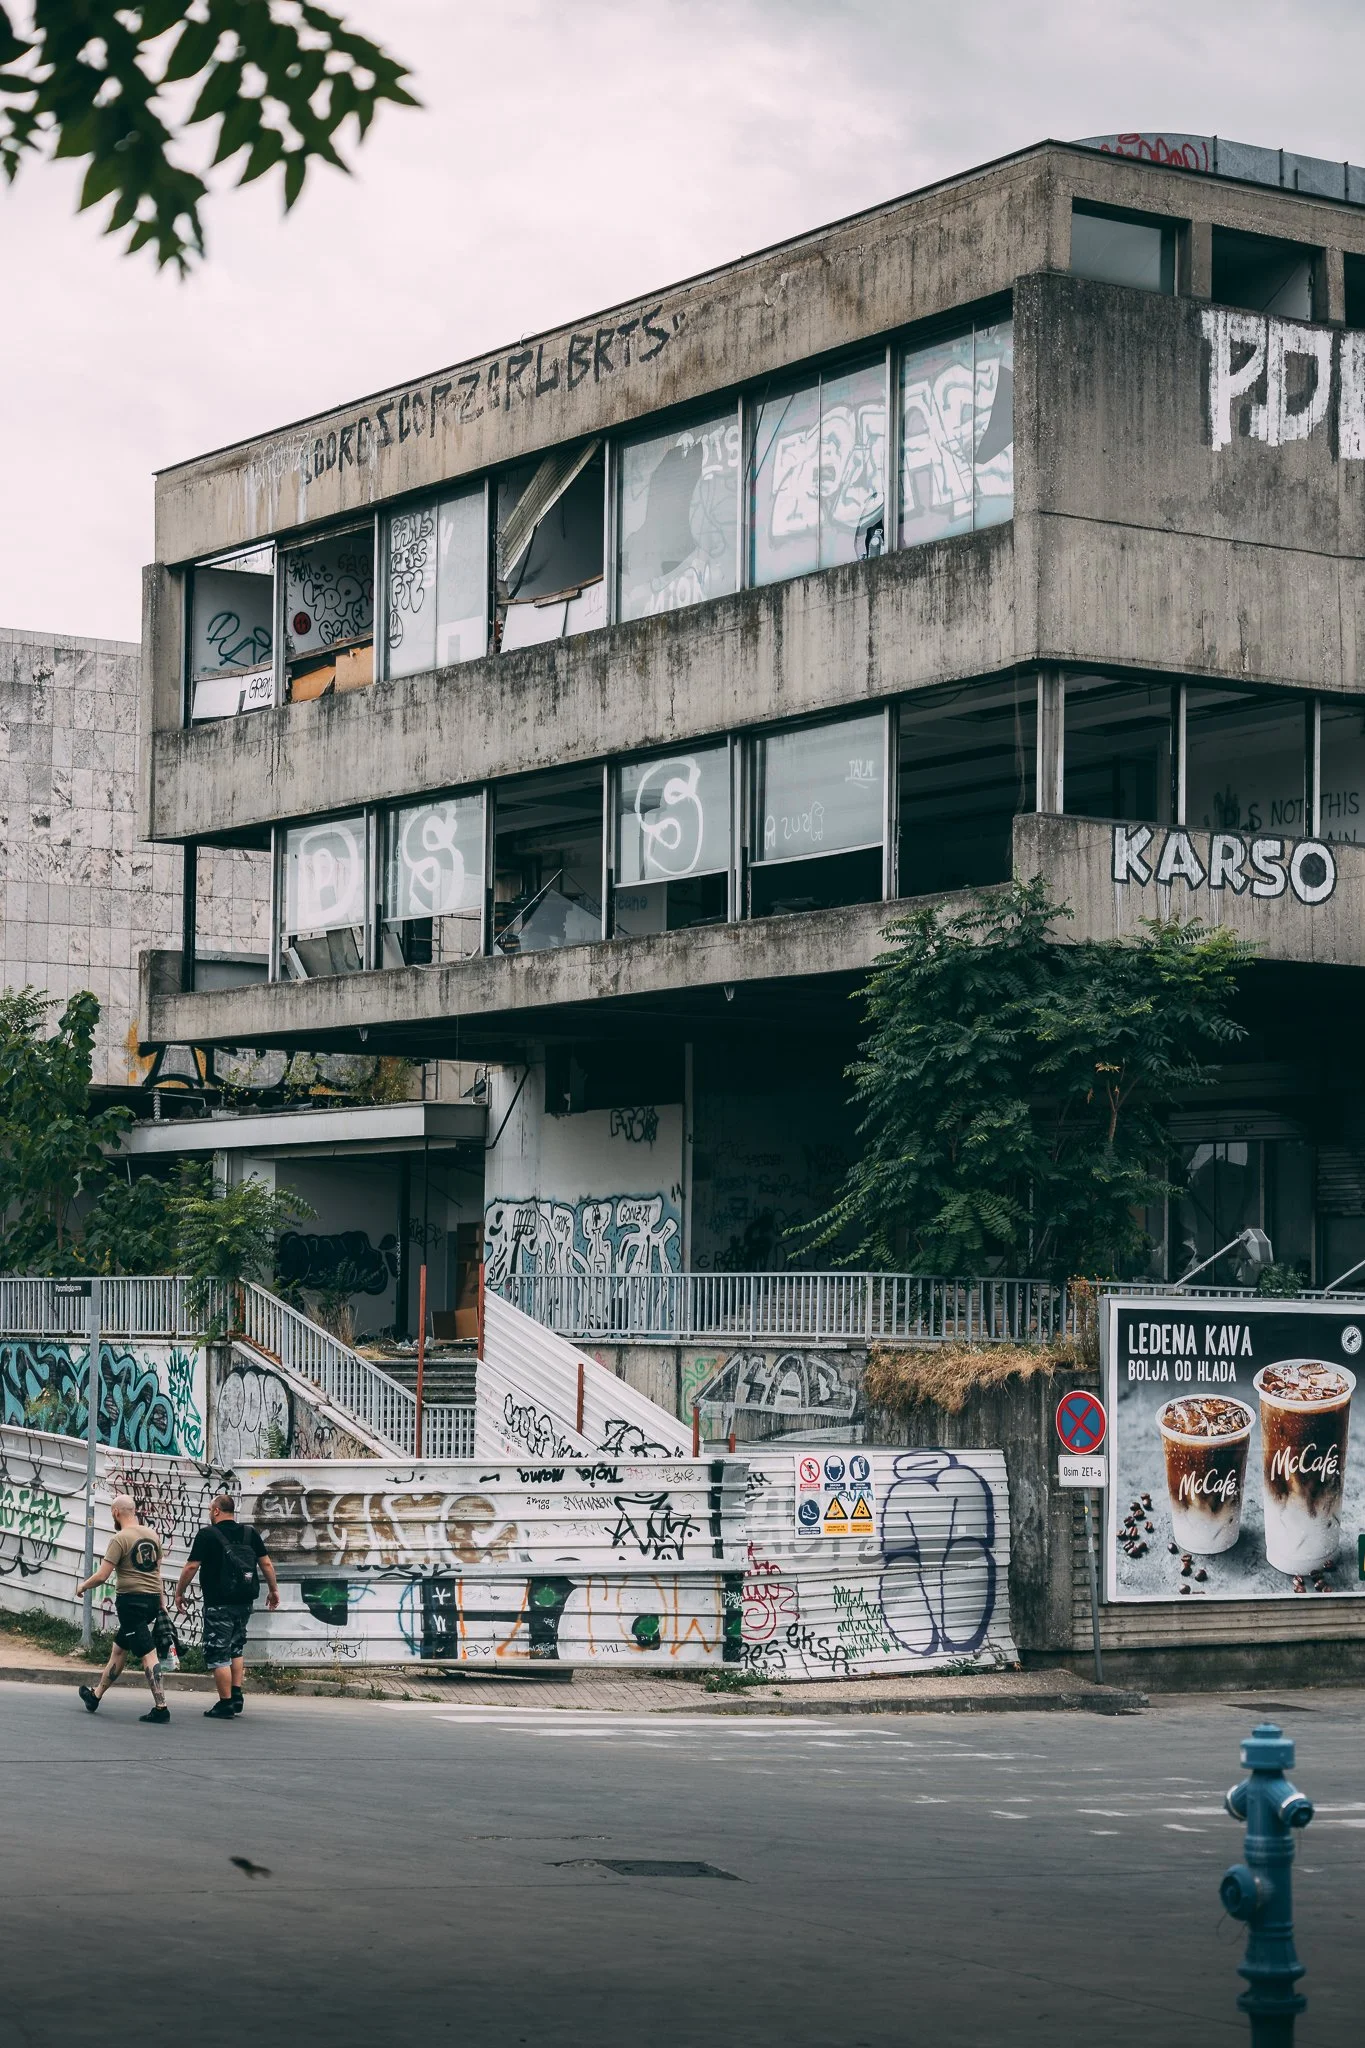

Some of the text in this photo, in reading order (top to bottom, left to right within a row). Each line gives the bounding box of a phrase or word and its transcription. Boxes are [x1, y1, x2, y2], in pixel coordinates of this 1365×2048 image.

[1110, 823, 1338, 907] KARSO
[1128, 1322, 1254, 1357] LEDENA KAVA
[1127, 1359, 1237, 1382] BOLJA OD HLADA
[1063, 1466, 1102, 1477] Osim ZET-a
[1271, 1442, 1338, 1483] McCafé
[1178, 1468, 1237, 1502] McCafé
